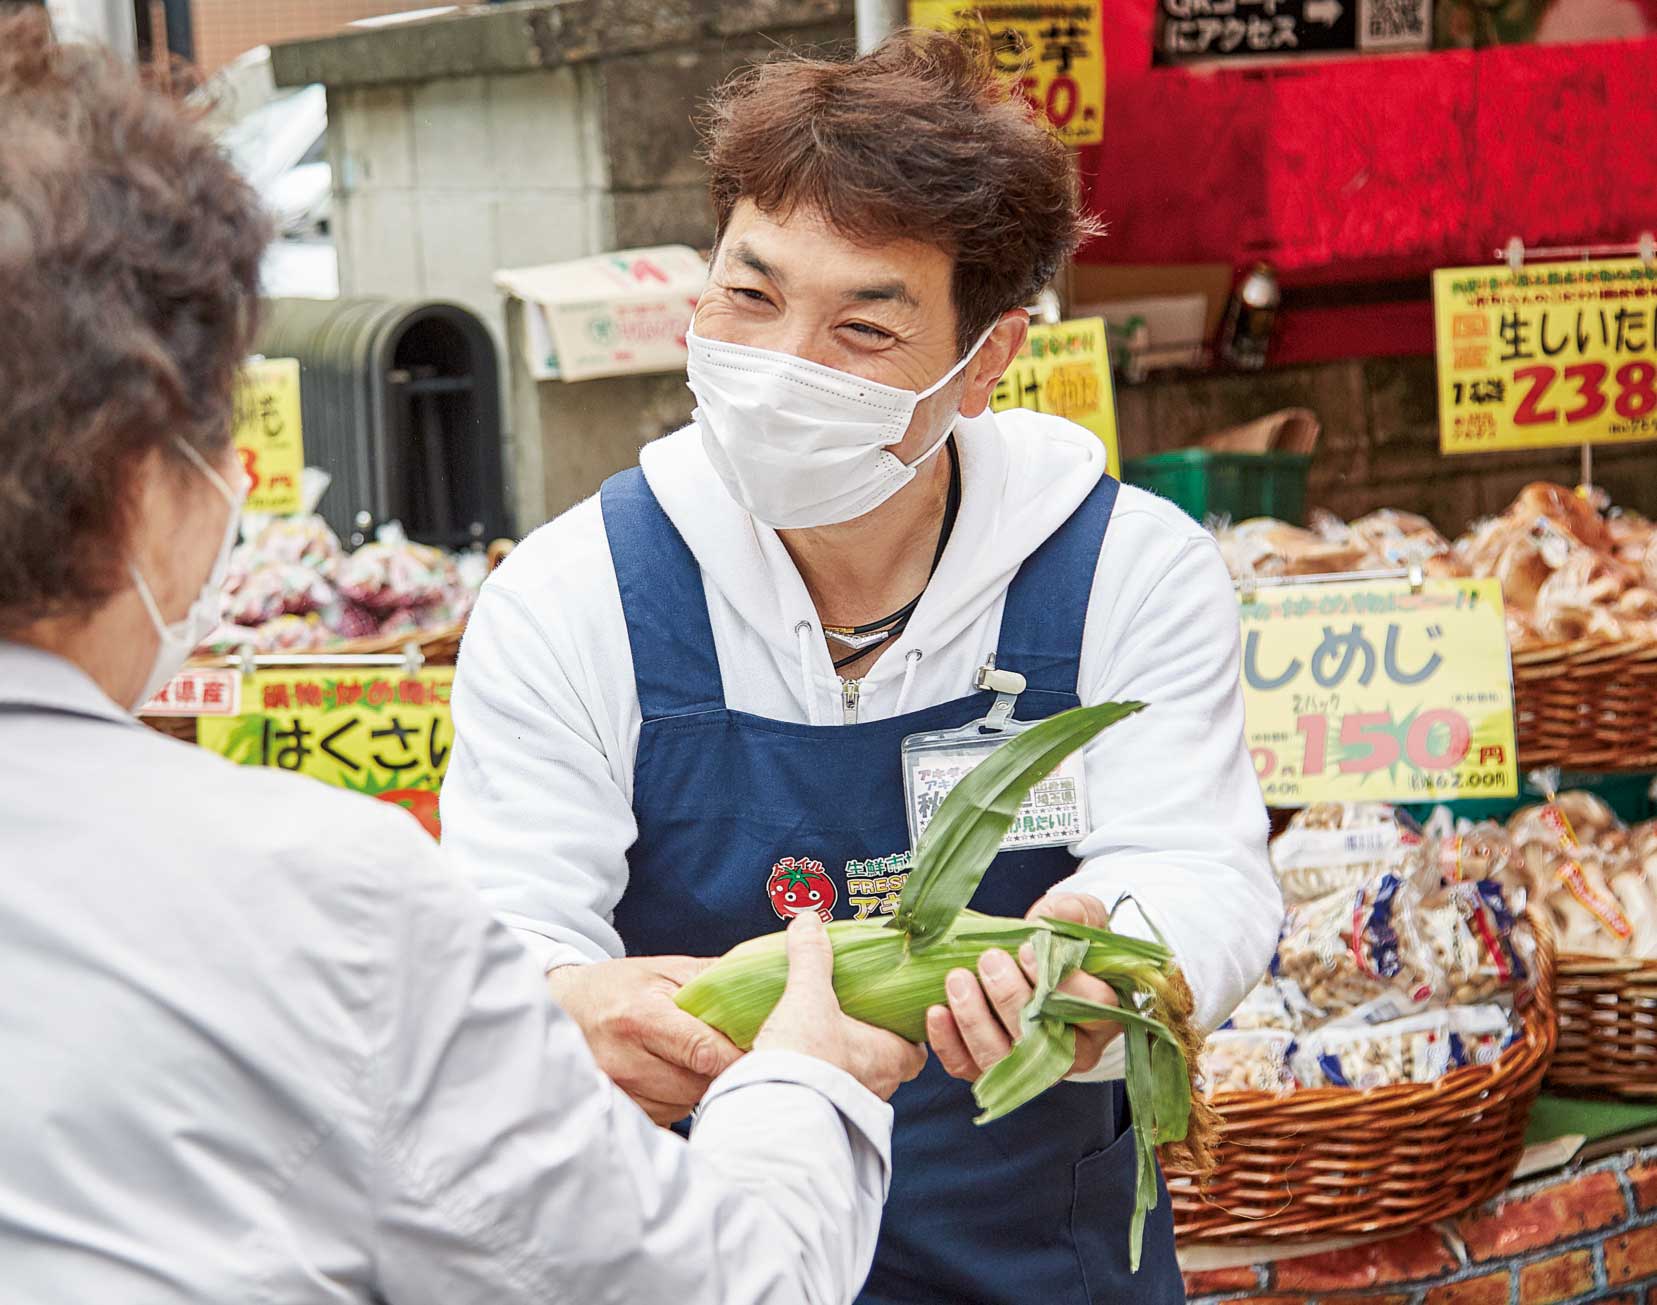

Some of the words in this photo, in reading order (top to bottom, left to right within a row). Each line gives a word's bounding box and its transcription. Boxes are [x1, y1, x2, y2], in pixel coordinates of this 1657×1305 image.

[1166, 16, 1297, 52] にアクセス
[1499, 307, 1657, 362] 生しいた
[1513, 361, 1657, 427] 238
[1244, 623, 1443, 691] しめじ
[1296, 708, 1471, 776] 150
[1479, 745, 1505, 767] 円
[1037, 791, 1075, 804] 埼玉県
